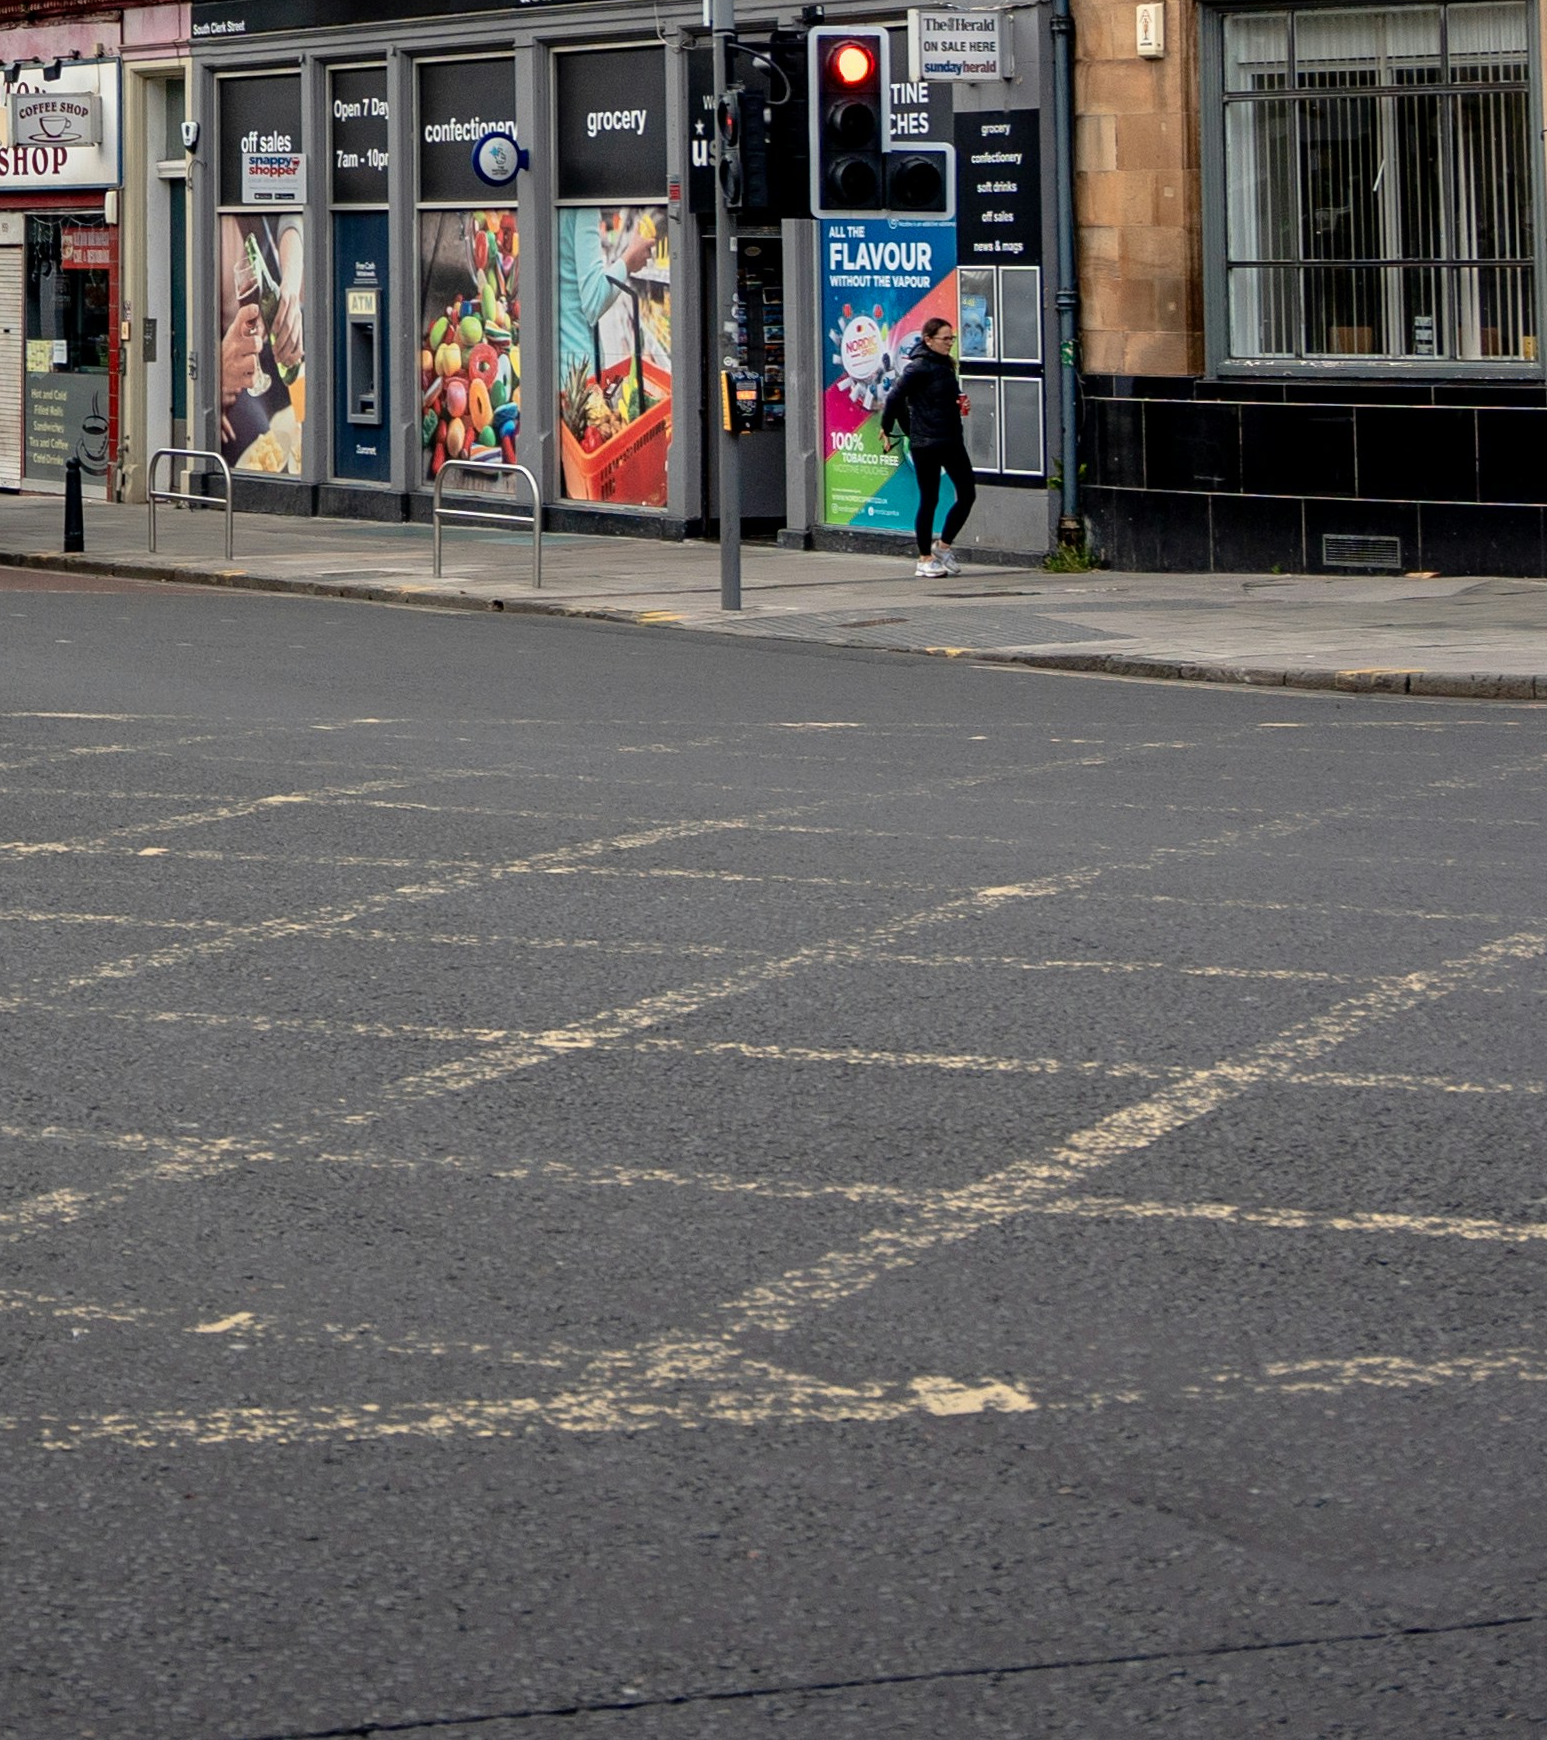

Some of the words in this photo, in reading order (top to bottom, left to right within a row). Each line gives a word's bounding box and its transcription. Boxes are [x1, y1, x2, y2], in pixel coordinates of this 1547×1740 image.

[193, 23, 210, 35] South
[210, 22, 227, 34] Clerk
[227, 20, 246, 33] Street
[924, 18, 946, 32] The
[955, 17, 995, 32] Herald
[924, 41, 939, 53] ON
[941, 41, 967, 53] SALE
[968, 40, 996, 53] HERE
[890, 82, 929, 104] TINE
[19, 101, 58, 120] COFFEE
[59, 101, 89, 118] SHOP
[334, 100, 360, 122] Open
[362, 99, 368, 116] 7
[371, 98, 389, 119] Day
[587, 109, 647, 138] grocery
[889, 111, 929, 135] CHES
[981, 123, 1011, 138] grocery
[241, 131, 258, 153] off
[259, 130, 292, 153] sales
[248, 156, 292, 168] snappy
[337, 150, 358, 168] 7am
[971, 150, 1022, 166] confectionery
[248, 164, 298, 178] shopper
[977, 180, 991, 193] soft
[993, 180, 1017, 193] drinks
[982, 211, 993, 223] off
[994, 211, 1014, 222] sales
[829, 226, 845, 238] ALL
[847, 226, 865, 238] THE
[973, 242, 994, 252] news
[995, 240, 1001, 252] &
[1002, 242, 1024, 254] mags
[829, 241, 932, 271] FLAVOUR
[829, 275, 872, 287] WITHOUT
[873, 275, 890, 287] THE
[891, 276, 931, 288] VAPOUR
[351, 295, 374, 311] ATM
[846, 335, 878, 354] NORDIC
[31, 389, 42, 399] Hot
[54, 390, 67, 401] Cold
[33, 421, 65, 433] Sandwiches
[29, 437, 40, 447] Tea
[53, 438, 69, 450] Coffee
[830, 431, 864, 451] 100%
[842, 452, 878, 465] TOBACCO
[880, 454, 899, 467] FREE
